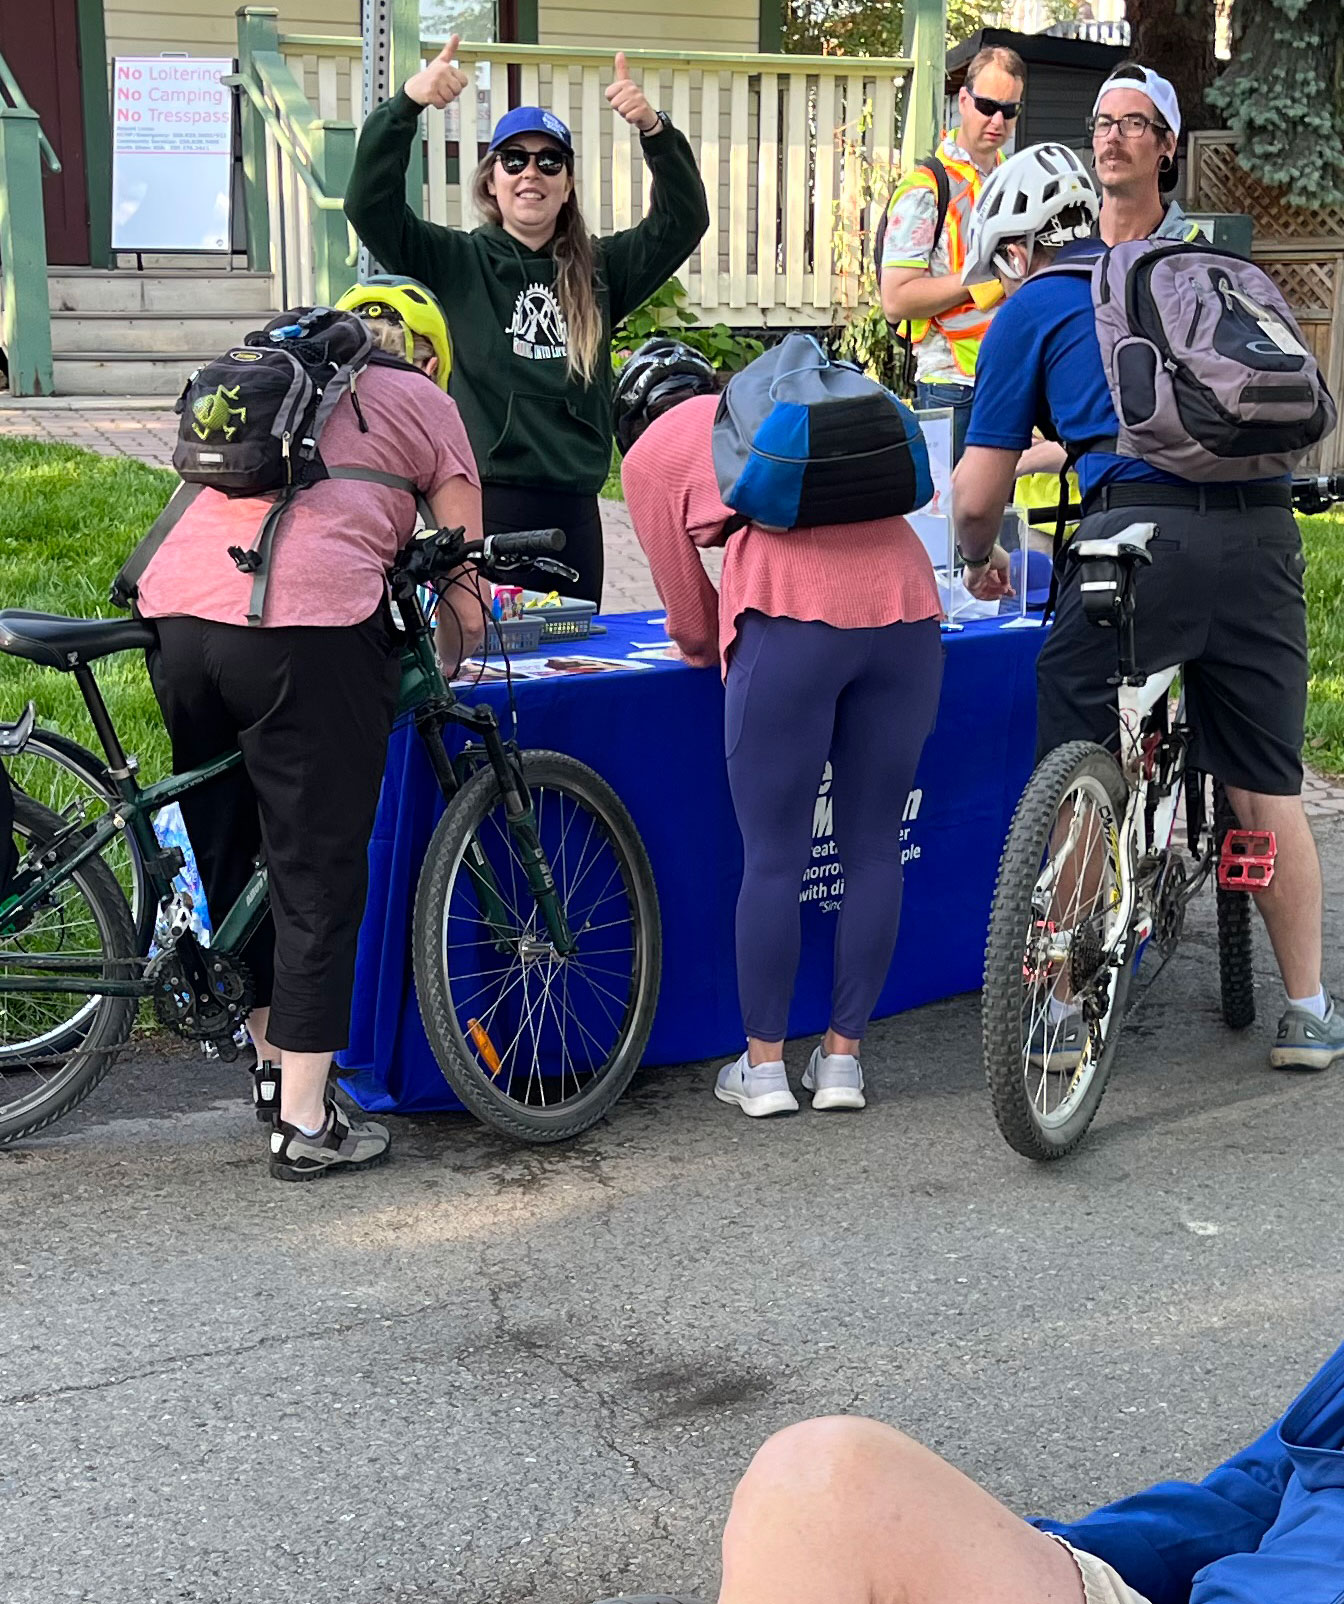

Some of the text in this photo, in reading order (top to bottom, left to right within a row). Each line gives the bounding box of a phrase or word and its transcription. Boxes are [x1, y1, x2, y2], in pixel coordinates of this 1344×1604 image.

[118, 66, 223, 84] No Loitering
[117, 87, 223, 105] No Camping
[117, 107, 229, 125] No Tresspass
